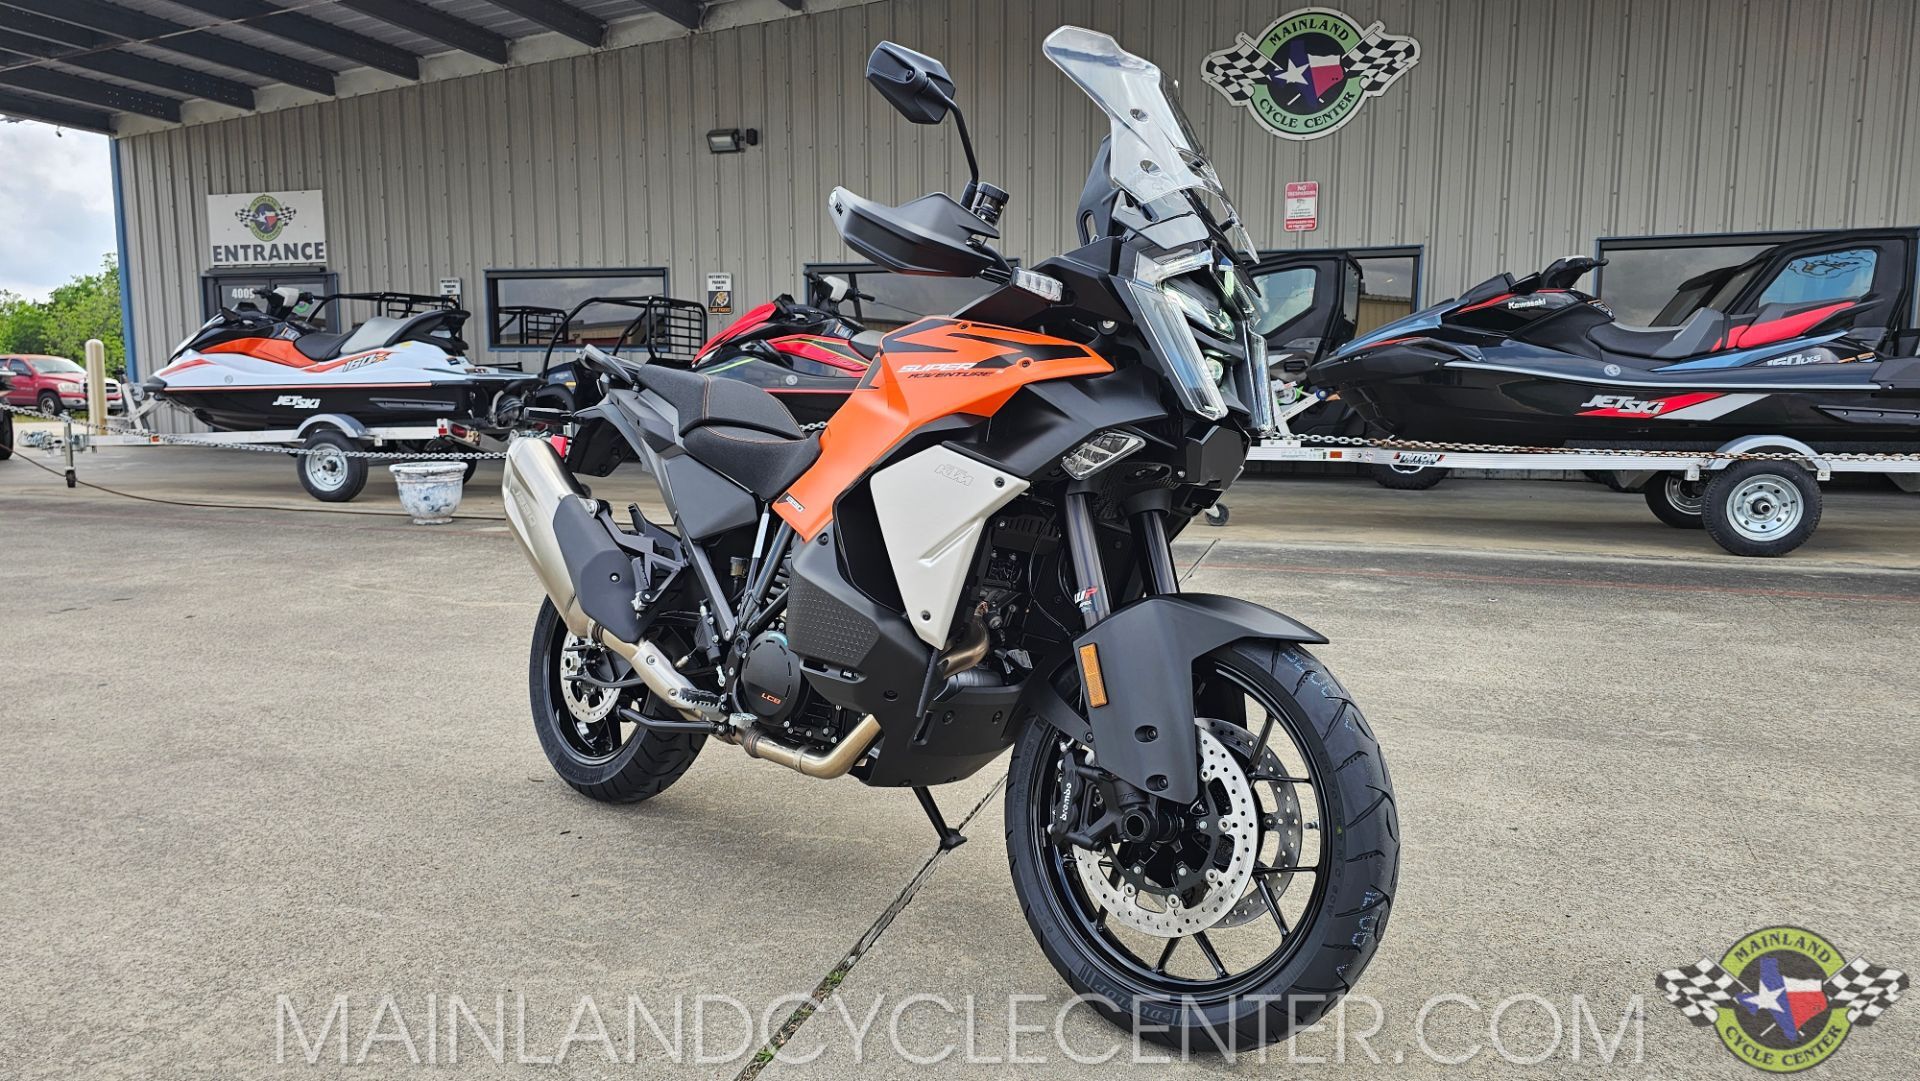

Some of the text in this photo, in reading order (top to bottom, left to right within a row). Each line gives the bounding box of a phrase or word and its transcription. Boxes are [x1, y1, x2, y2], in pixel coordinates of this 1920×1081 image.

[1269, 18, 1349, 47] MAINLAND
[1259, 92, 1355, 129] CYCLE CENTER
[212, 242, 325, 262] ENTRANCE
[1508, 298, 1547, 310] Kawasaki
[897, 362, 978, 373] SUPER
[907, 371, 995, 379] ADVENTURE
[1400, 453, 1440, 463] TRITON
[934, 464, 974, 487] KTM
[761, 692, 782, 705] LC8
